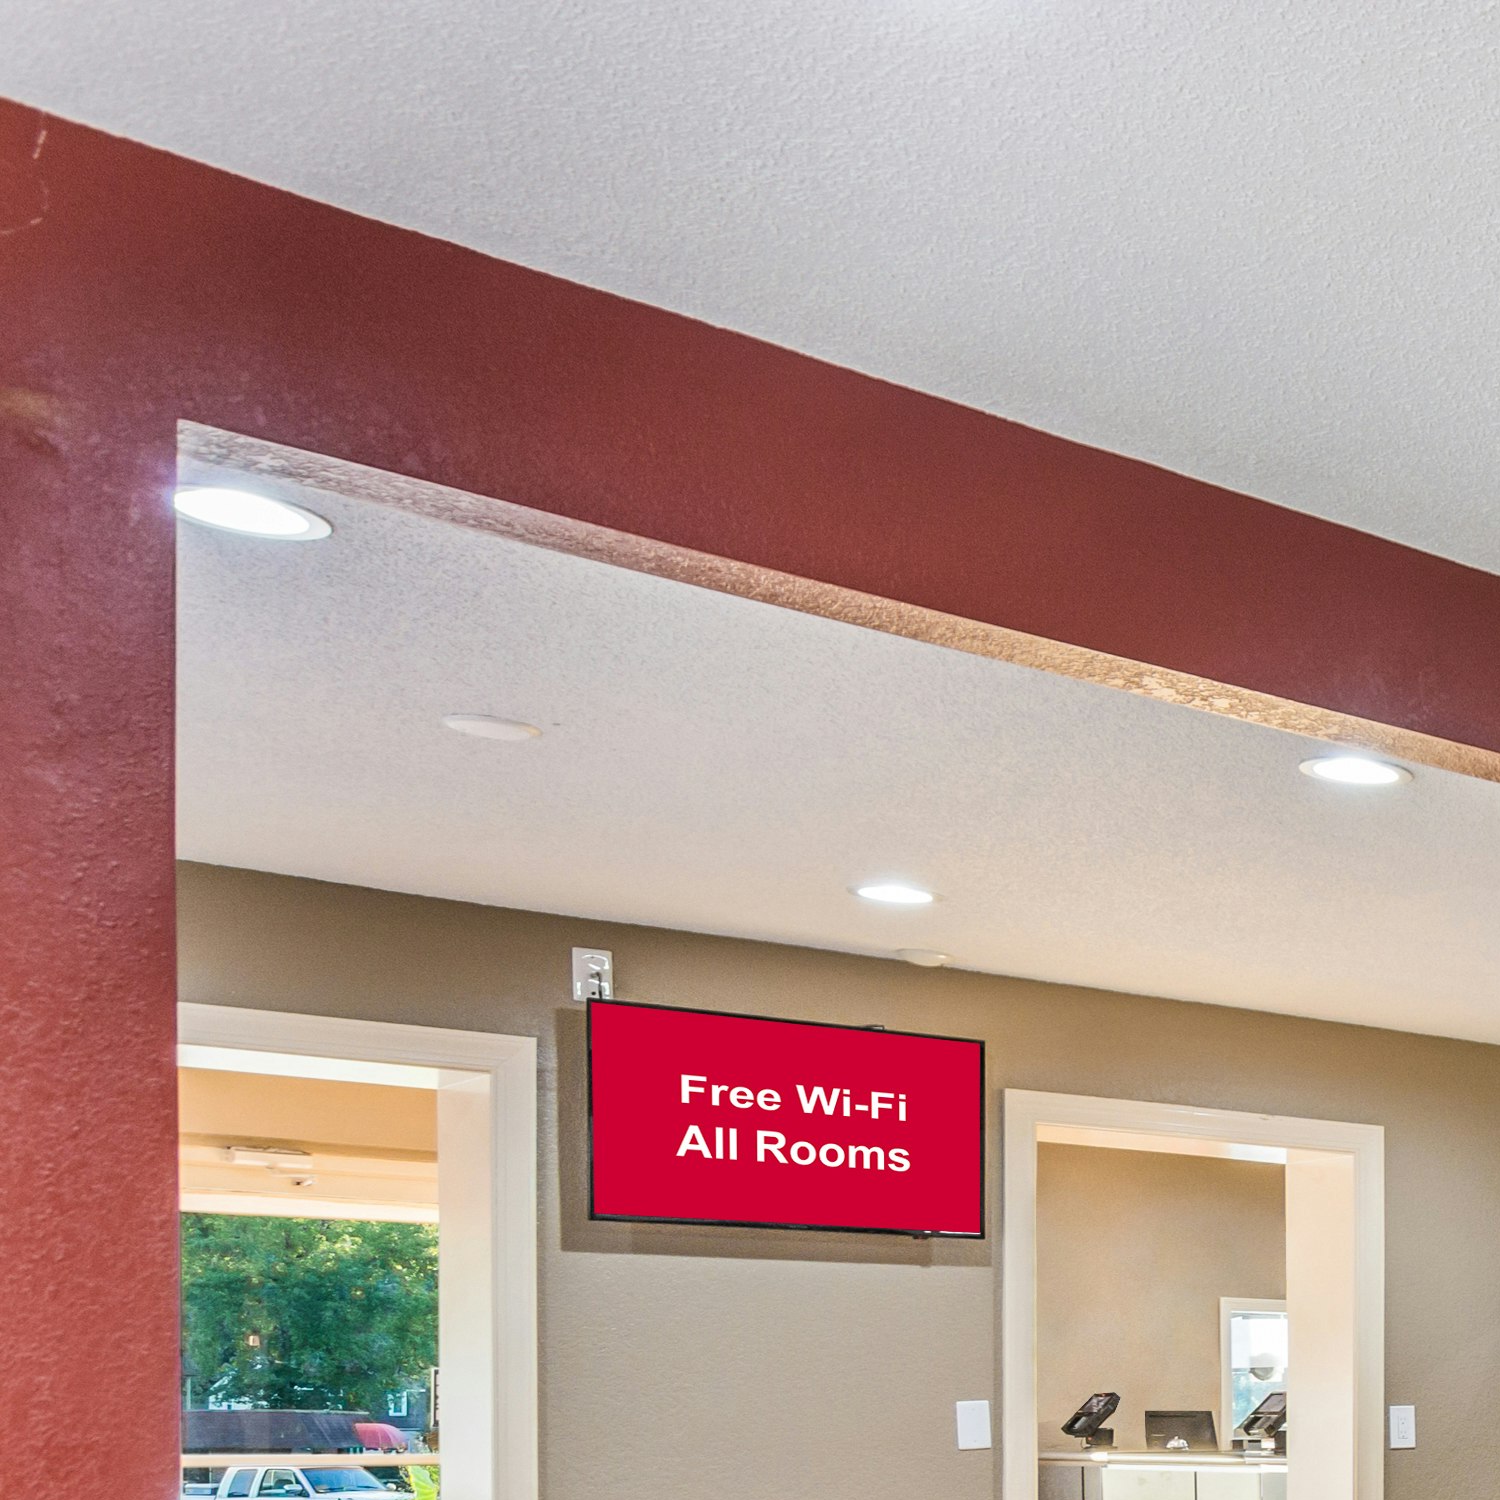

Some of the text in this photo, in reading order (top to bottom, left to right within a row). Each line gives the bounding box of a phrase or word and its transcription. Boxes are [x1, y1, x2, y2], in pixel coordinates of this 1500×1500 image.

[681, 1074, 907, 1121] Free Wi-Fi
[676, 1124, 911, 1172] All Rooms
